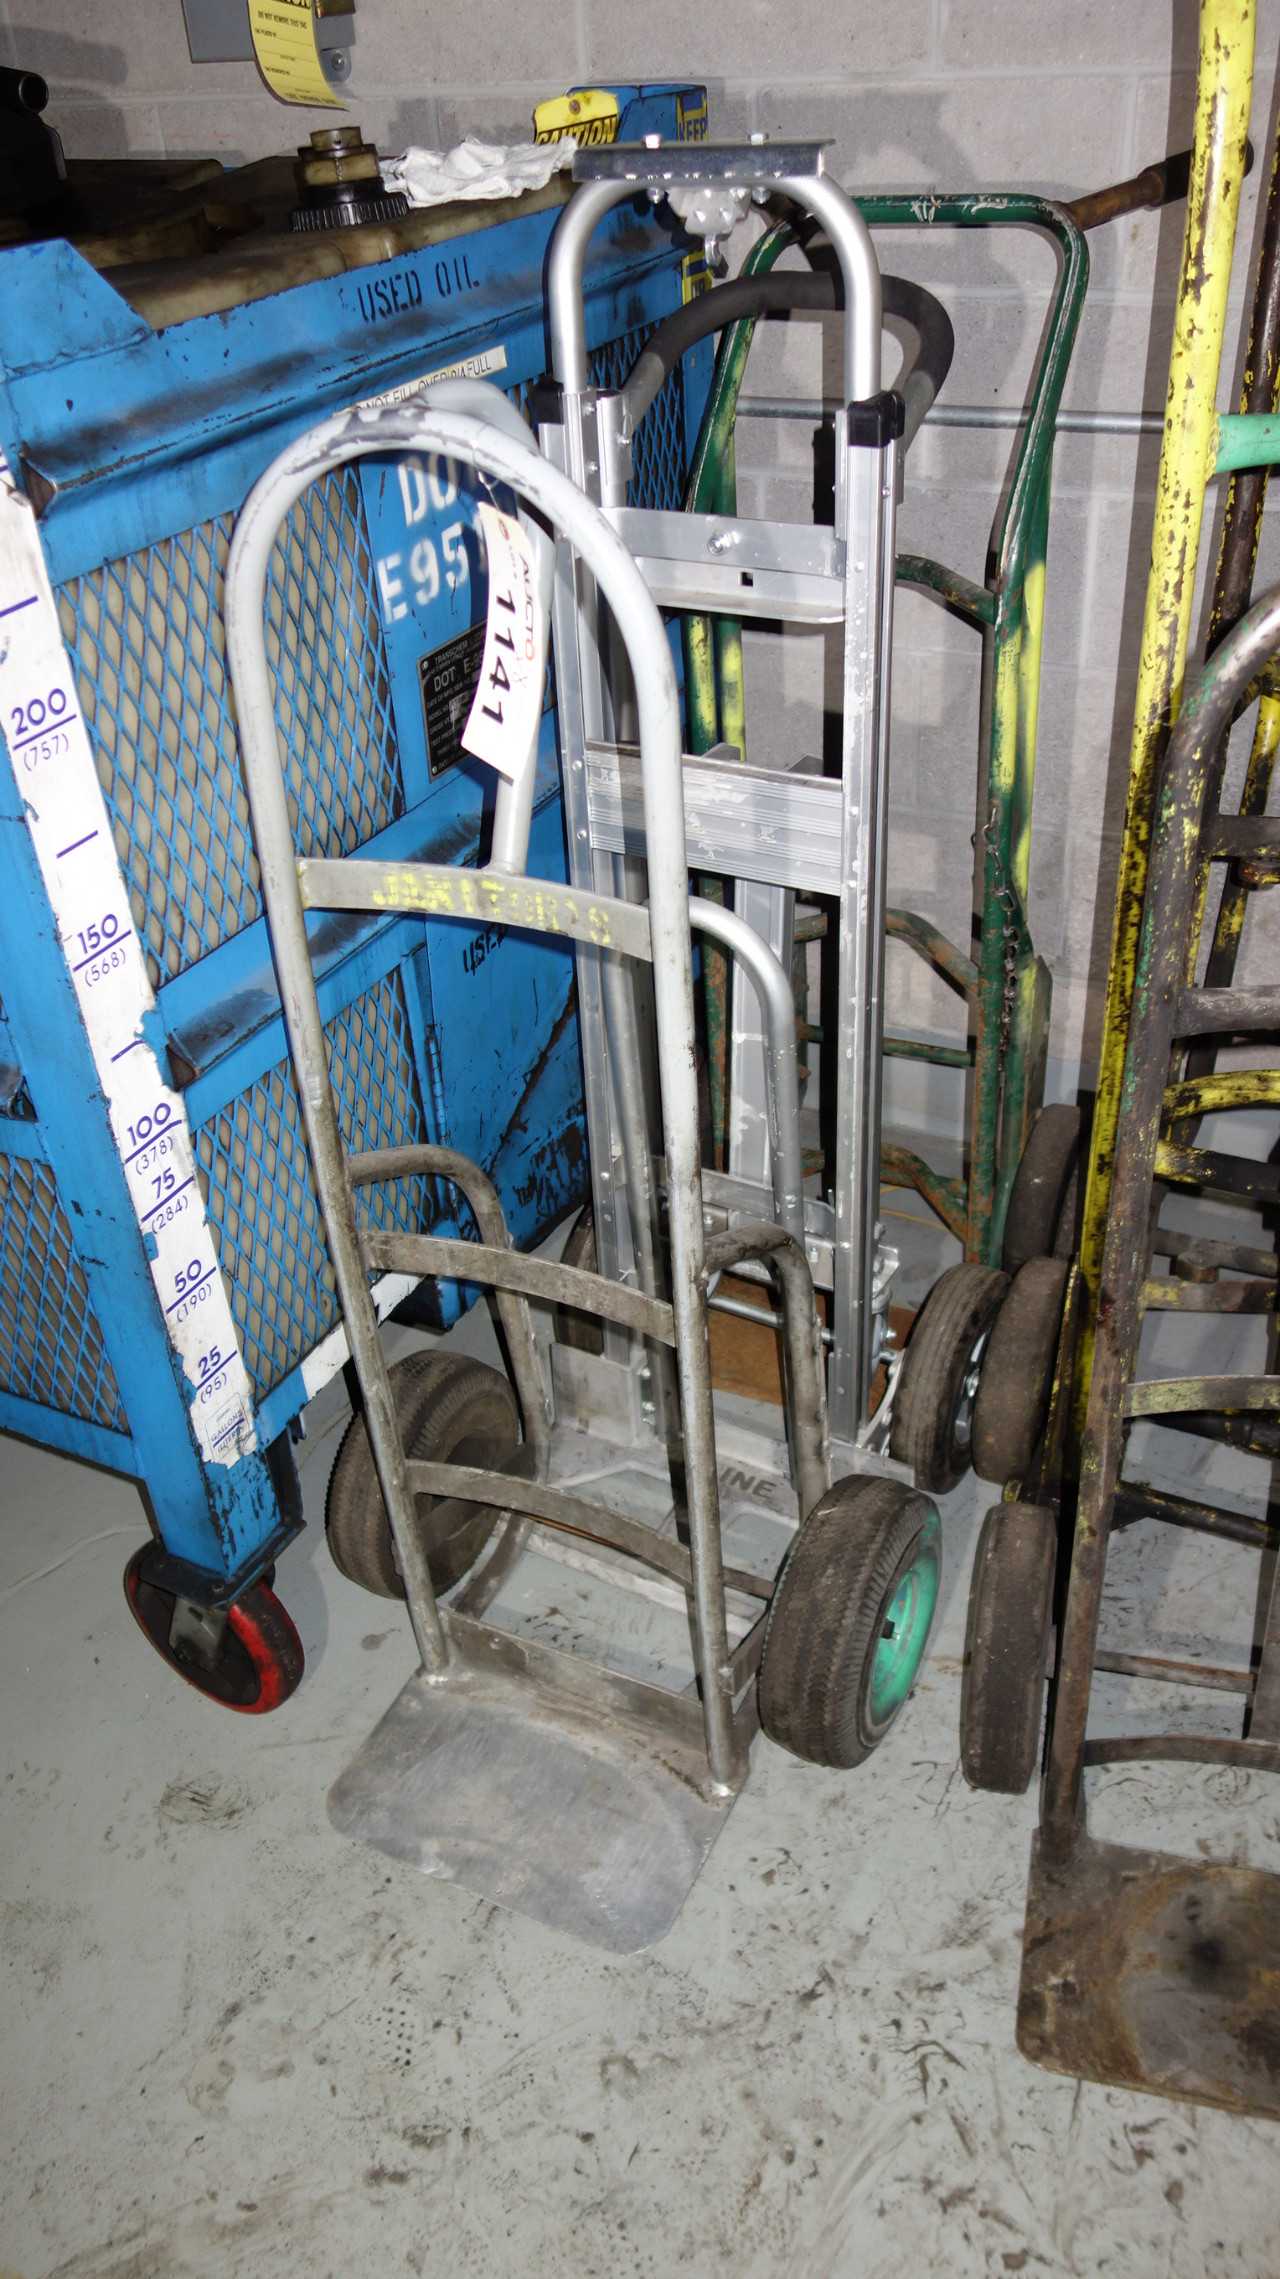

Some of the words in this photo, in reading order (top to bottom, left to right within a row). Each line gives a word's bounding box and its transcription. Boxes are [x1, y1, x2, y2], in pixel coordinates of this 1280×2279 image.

[357, 269, 422, 323] USED
[467, 355, 491, 376] FULL
[481, 590, 515, 724] 1141
[433, 666, 456, 692] DOT
[12, 687, 66, 735] 200
[24, 733, 69, 771] (757)
[77, 914, 118, 954] 150
[85, 949, 127, 987] (568)
[127, 1103, 171, 1146] 100
[135, 1136, 174, 1175] (378)
[151, 1168, 175, 1200] 75
[151, 1196, 188, 1234] (284)
[174, 1259, 201, 1293] 50
[177, 1283, 212, 1323] (190)
[198, 1345, 221, 1378] 25
[200, 1372, 227, 1404] (95)
